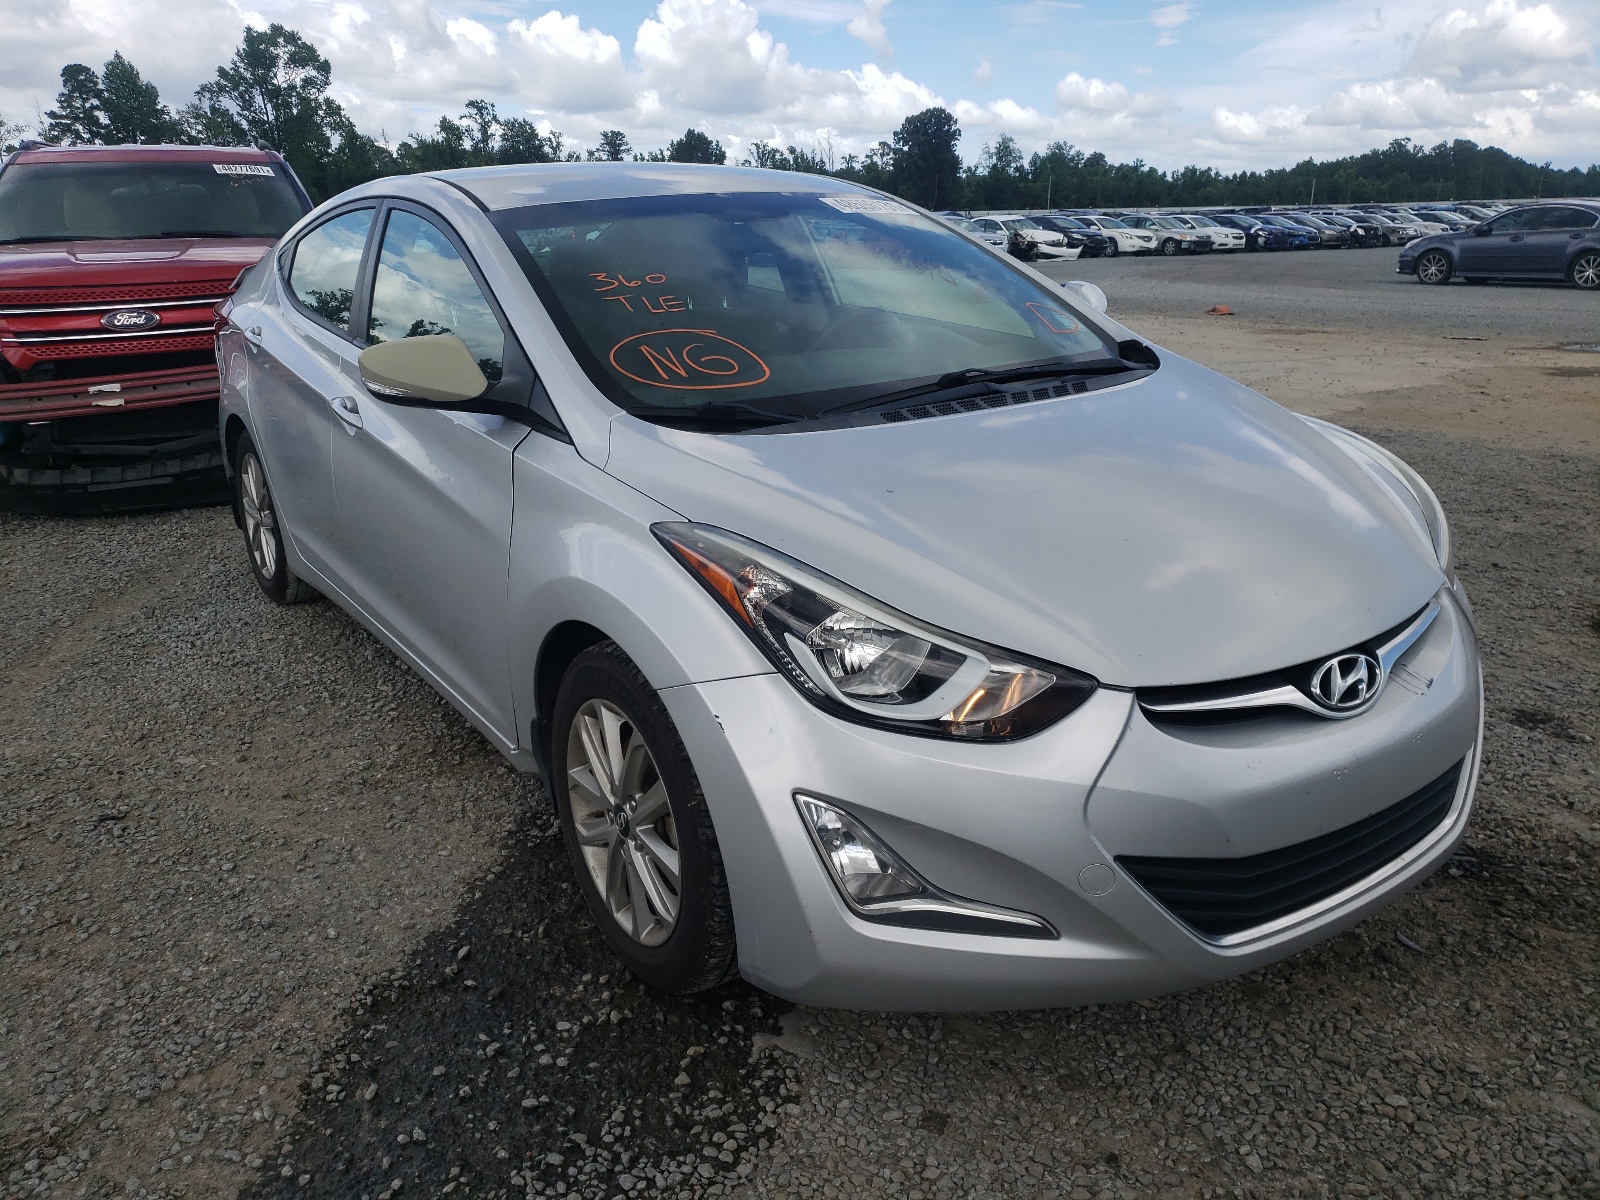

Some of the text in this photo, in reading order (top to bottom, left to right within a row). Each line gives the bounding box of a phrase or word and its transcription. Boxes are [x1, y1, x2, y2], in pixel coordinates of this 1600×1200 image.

[588, 272, 666, 291] 360
[602, 294, 686, 313] TLE
[114, 313, 146, 325] Ford
[638, 343, 738, 380] NG
